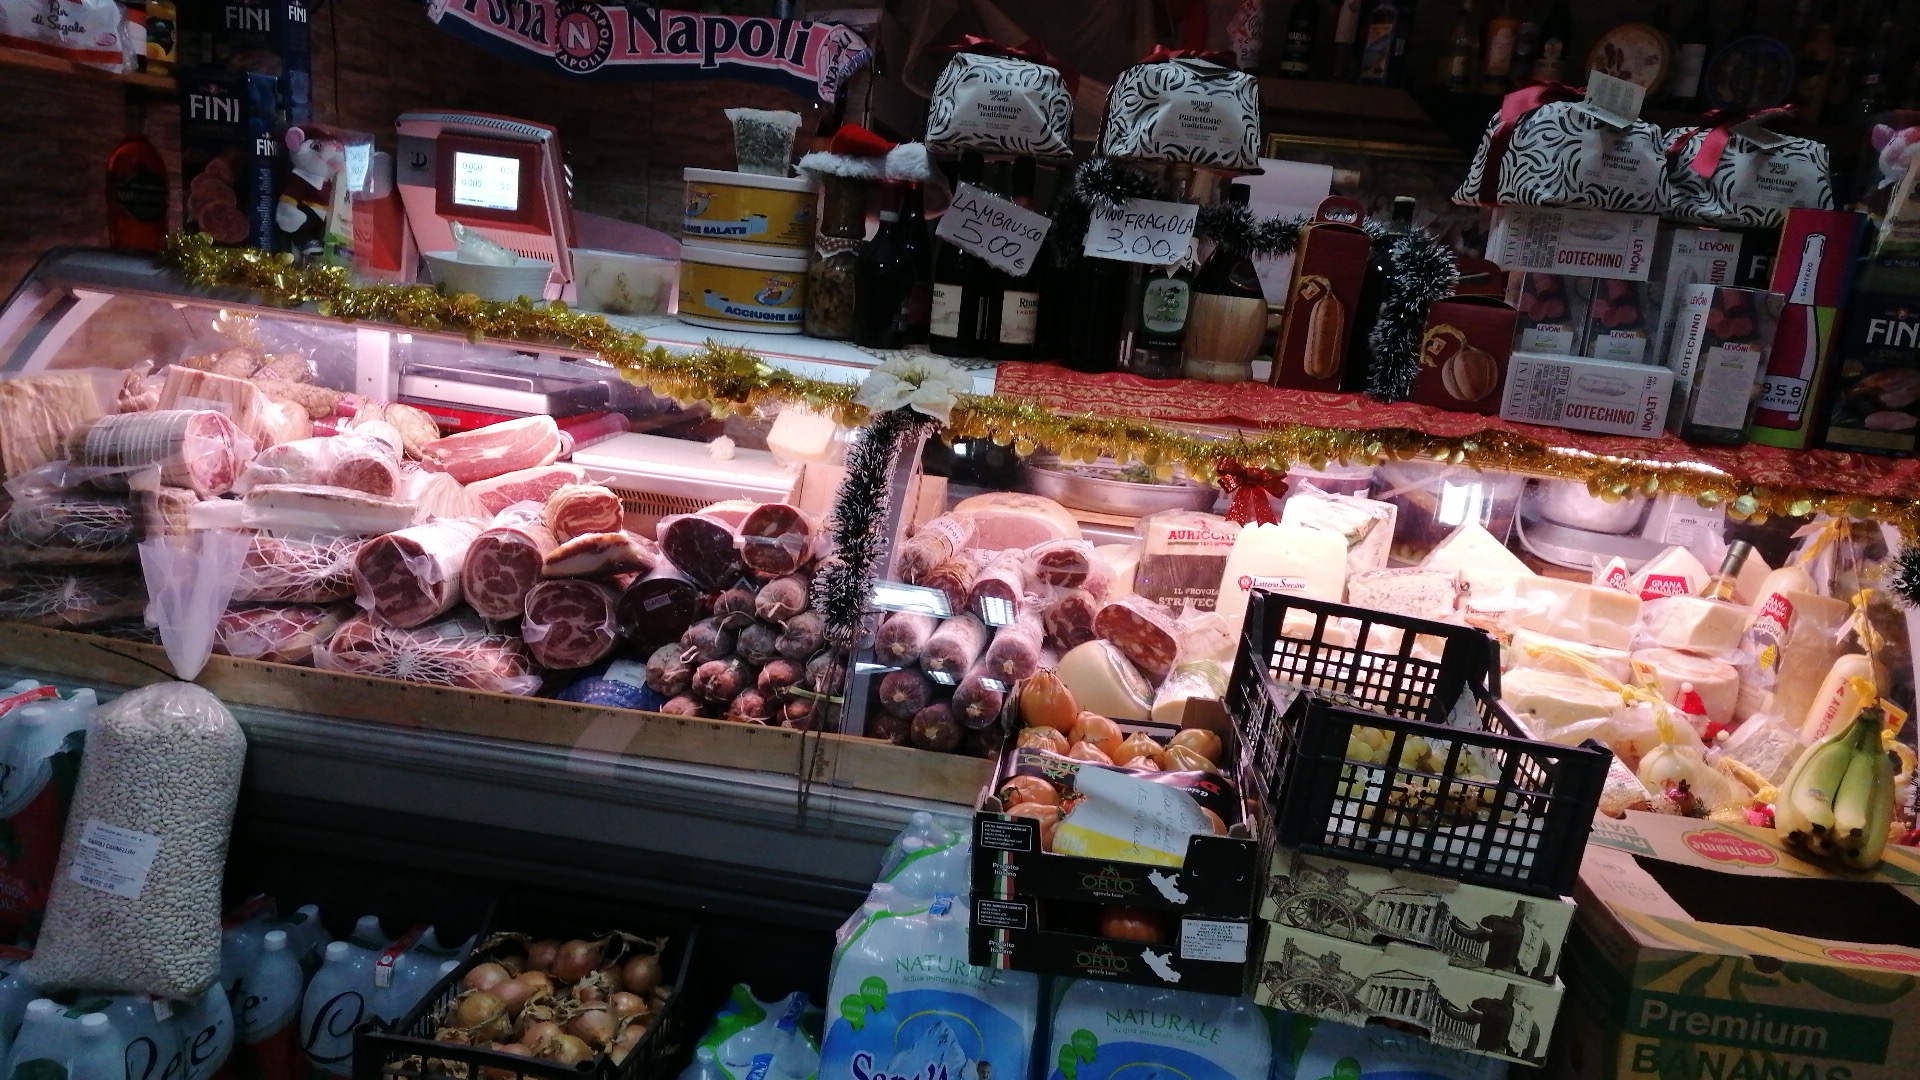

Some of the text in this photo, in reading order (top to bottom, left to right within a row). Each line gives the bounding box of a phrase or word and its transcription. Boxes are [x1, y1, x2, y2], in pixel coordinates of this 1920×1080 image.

[225, 5, 271, 32] FINI
[288, 4, 307, 23] FINI
[31, 15, 87, 35] di Segale
[626, 5, 814, 68] Napoli
[190, 93, 241, 124] FINI
[976, 103, 1022, 115] Panettone
[1178, 113, 1223, 126] Panettone
[256, 138, 277, 158] FIN
[1602, 153, 1642, 166] Panettone
[1754, 175, 1799, 188] Panettone
[952, 194, 1043, 242] LAMBRUSCO
[1095, 207, 1195, 236] VINO FRAGOLA
[1628, 239, 1644, 274] LEVONI
[1698, 242, 1735, 253] LEVONI
[1557, 249, 1623, 269] COTECHINO
[1800, 261, 1814, 297] SANTERO
[724, 305, 786, 321] ACCIUGHE
[1536, 325, 1562, 334] LEVONI
[1610, 331, 1636, 340] LEVONI
[1865, 318, 1920, 348] FIN
[1680, 312, 1702, 378] COTECHINO
[1724, 343, 1750, 353] LEVONI
[1558, 366, 1571, 385] COTTO
[1565, 403, 1635, 425] COTECHINO
[1641, 396, 1658, 432] LEVONI
[1167, 529, 1238, 542] AURICCHI
[1173, 588, 1183, 596] IL
[1252, 577, 1307, 590] Latteria Soresina
[1650, 580, 1683, 589] GRANA
[1751, 622, 1783, 639] MANTOVA
[1691, 839, 1772, 860] Del Monte
[992, 862, 1020, 871] Prodotto
[988, 939, 1015, 949] Prodotto
[896, 953, 1006, 989] NATURALE
[902, 974, 924, 984] Acqua
[925, 975, 958, 986] minerale
[1105, 1007, 1225, 1045] NATURALE
[1638, 998, 1829, 1050] Premium
[1113, 1026, 1208, 1049] Acqua minerale naturale
[1630, 1042, 1854, 1080] BANANAS
